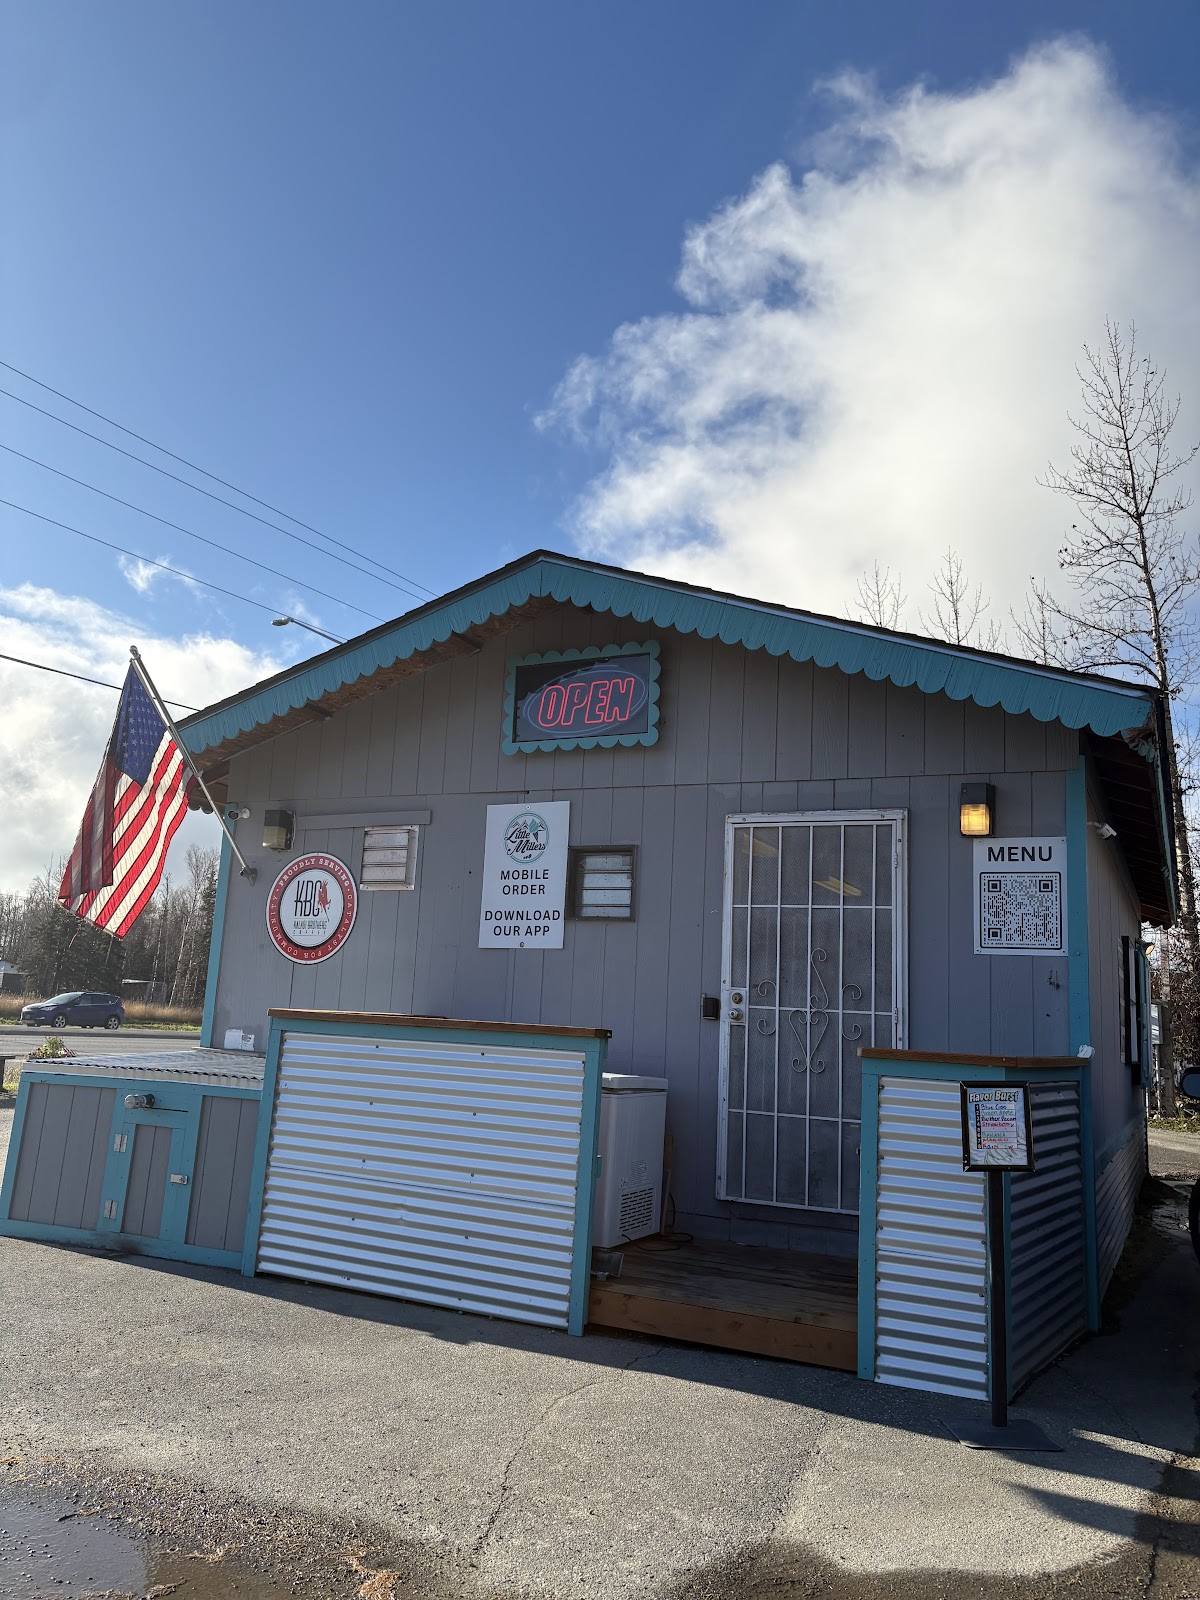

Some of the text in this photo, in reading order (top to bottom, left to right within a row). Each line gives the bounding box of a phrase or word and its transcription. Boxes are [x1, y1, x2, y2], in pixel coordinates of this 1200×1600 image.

[538, 677, 635, 728] OPEN
[504, 827, 531, 844] Little
[507, 840, 546, 855] Millers
[987, 846, 1053, 862] MENU
[279, 858, 350, 887] PROUDLY SERVING
[500, 869, 550, 880] MOBILE
[502, 884, 546, 895] ORDER
[294, 880, 322, 917] KBC
[484, 910, 561, 921] DOWNLOAD
[270, 894, 353, 959] CATALYST FOR COMMUNITY
[493, 925, 550, 936] OUR APP
[969, 1090, 1019, 1103] Flavor Burst
